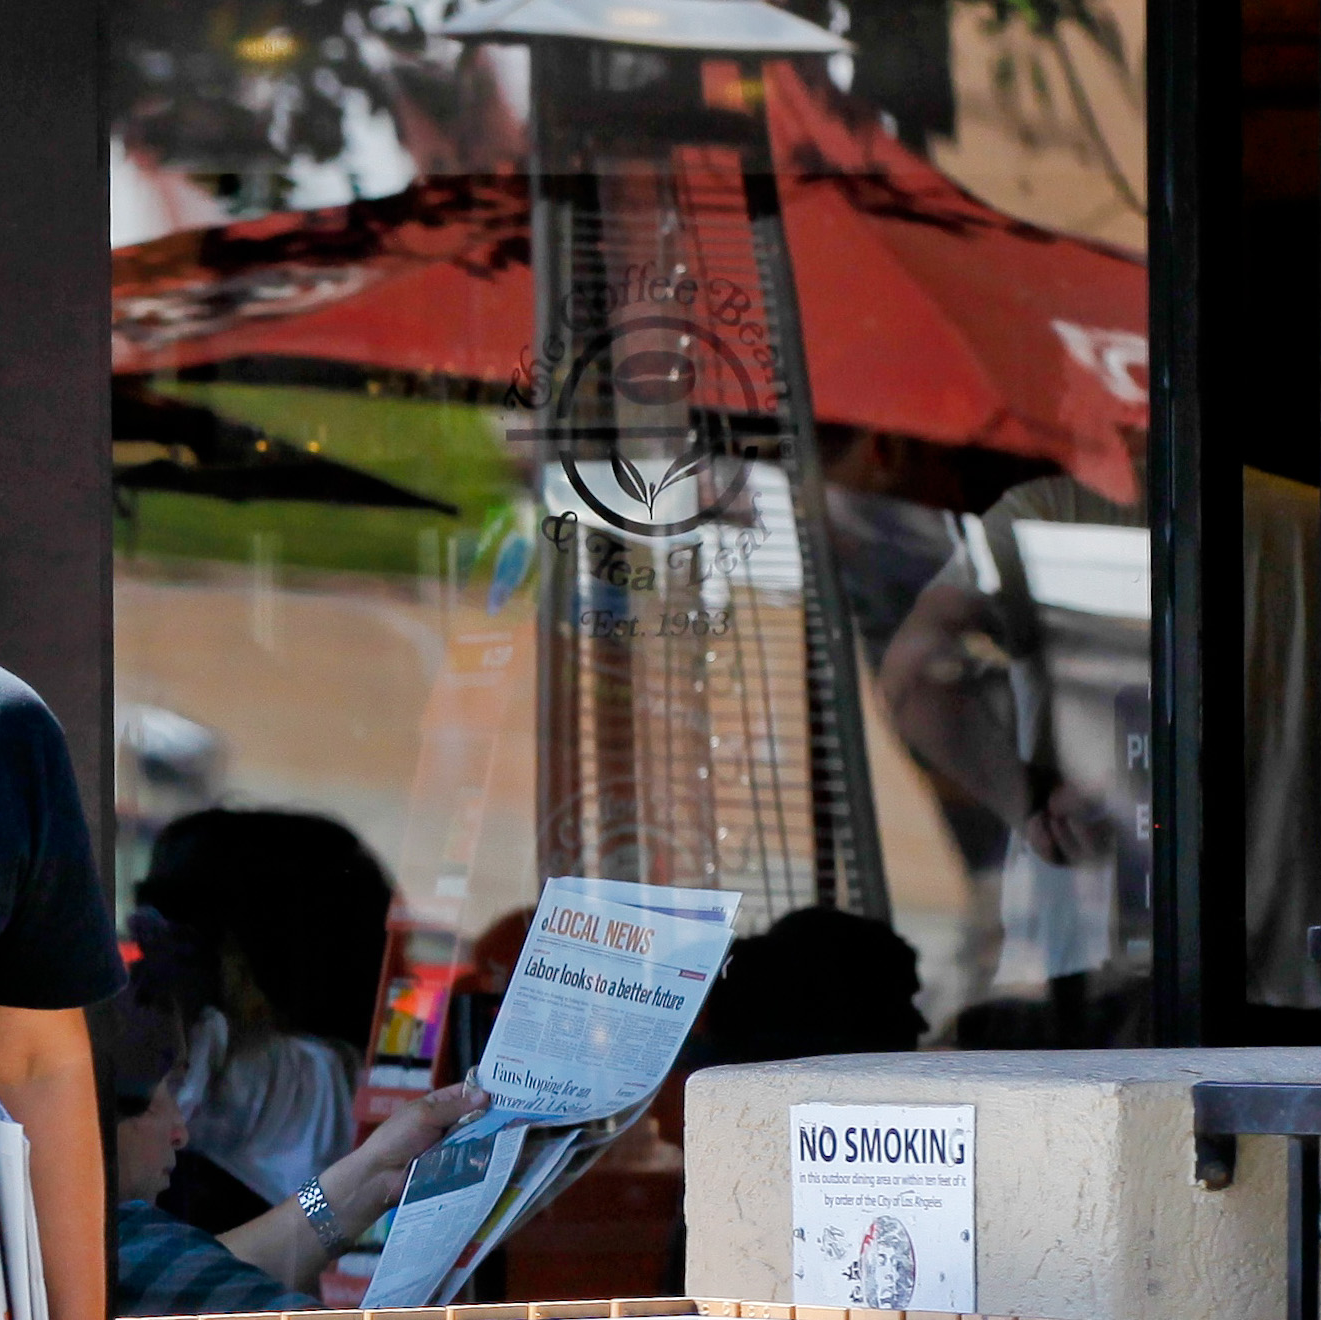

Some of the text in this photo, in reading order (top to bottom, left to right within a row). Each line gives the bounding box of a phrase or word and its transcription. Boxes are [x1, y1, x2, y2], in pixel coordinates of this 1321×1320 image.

[503, 262, 788, 412] The Coffee Bean
[541, 492, 774, 591] & Tea Leaf
[581, 610, 732, 639] Est. 1963
[547, 905, 600, 943] LOCAL
[603, 920, 656, 955] NEWS
[524, 956, 560, 982] Labor
[559, 963, 592, 991] looks
[593, 974, 608, 994] to
[607, 980, 617, 996] a
[616, 977, 653, 1004] better
[650, 985, 686, 1011] future
[492, 1062, 522, 1086] Fans
[525, 1069, 562, 1097] hoping
[561, 1079, 579, 1096] for
[799, 1127, 965, 1165] NO SMOKING
[799, 1172, 807, 1183] in
[808, 1172, 821, 1183] this
[822, 1172, 851, 1184] outdoor
[852, 1172, 875, 1188] dining
[876, 1175, 892, 1185] area
[893, 1176, 901, 1185] or
[902, 1173, 923, 1186] within
[937, 1174, 952, 1186] feet
[952, 1174, 962, 1187] of
[824, 1193, 943, 1210] by order of the City of Los Angeles
